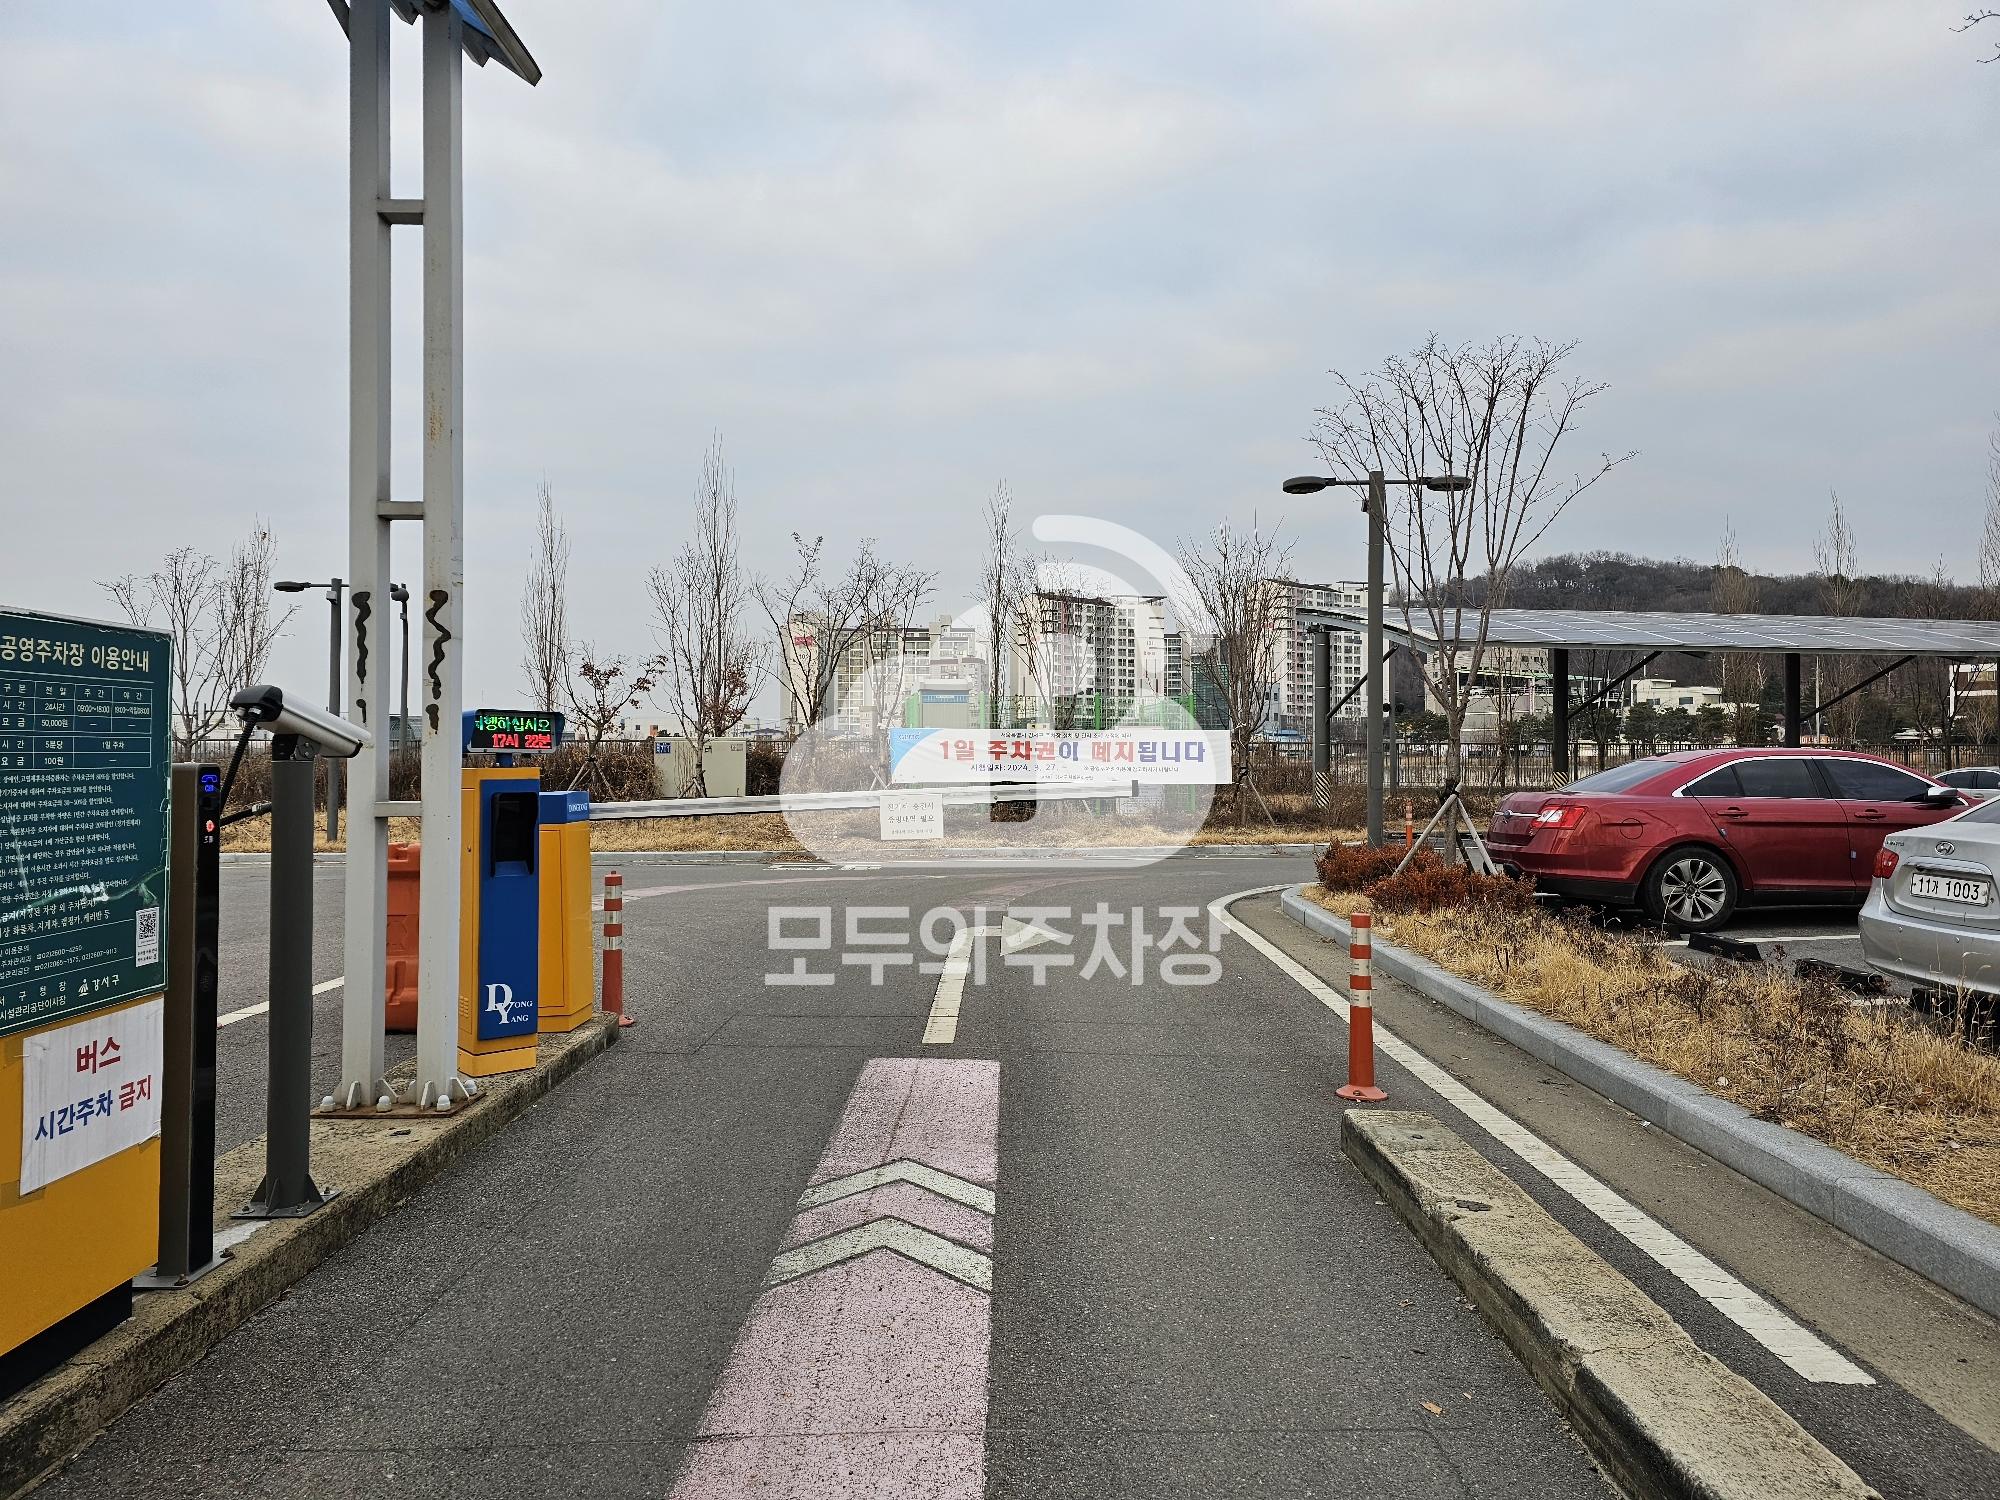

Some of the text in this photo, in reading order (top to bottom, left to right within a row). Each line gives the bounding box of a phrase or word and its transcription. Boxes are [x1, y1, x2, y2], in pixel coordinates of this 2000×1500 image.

[0, 635, 149, 672] 공영주차장 이용안내
[44, 702, 66, 711] 24시간
[41, 718, 69, 728] 50,000원
[45, 740, 63, 749] 5분당
[492, 733, 519, 748] 17시
[939, 739, 1206, 763] 1일 주차권이 폐지됩니다
[44, 756, 64, 766] 100원
[1946, 880, 1980, 901] 1003
[91, 974, 120, 992] 강서구
[76, 1036, 121, 1074] 버스
[34, 1074, 152, 1141] 시간주차 금지
